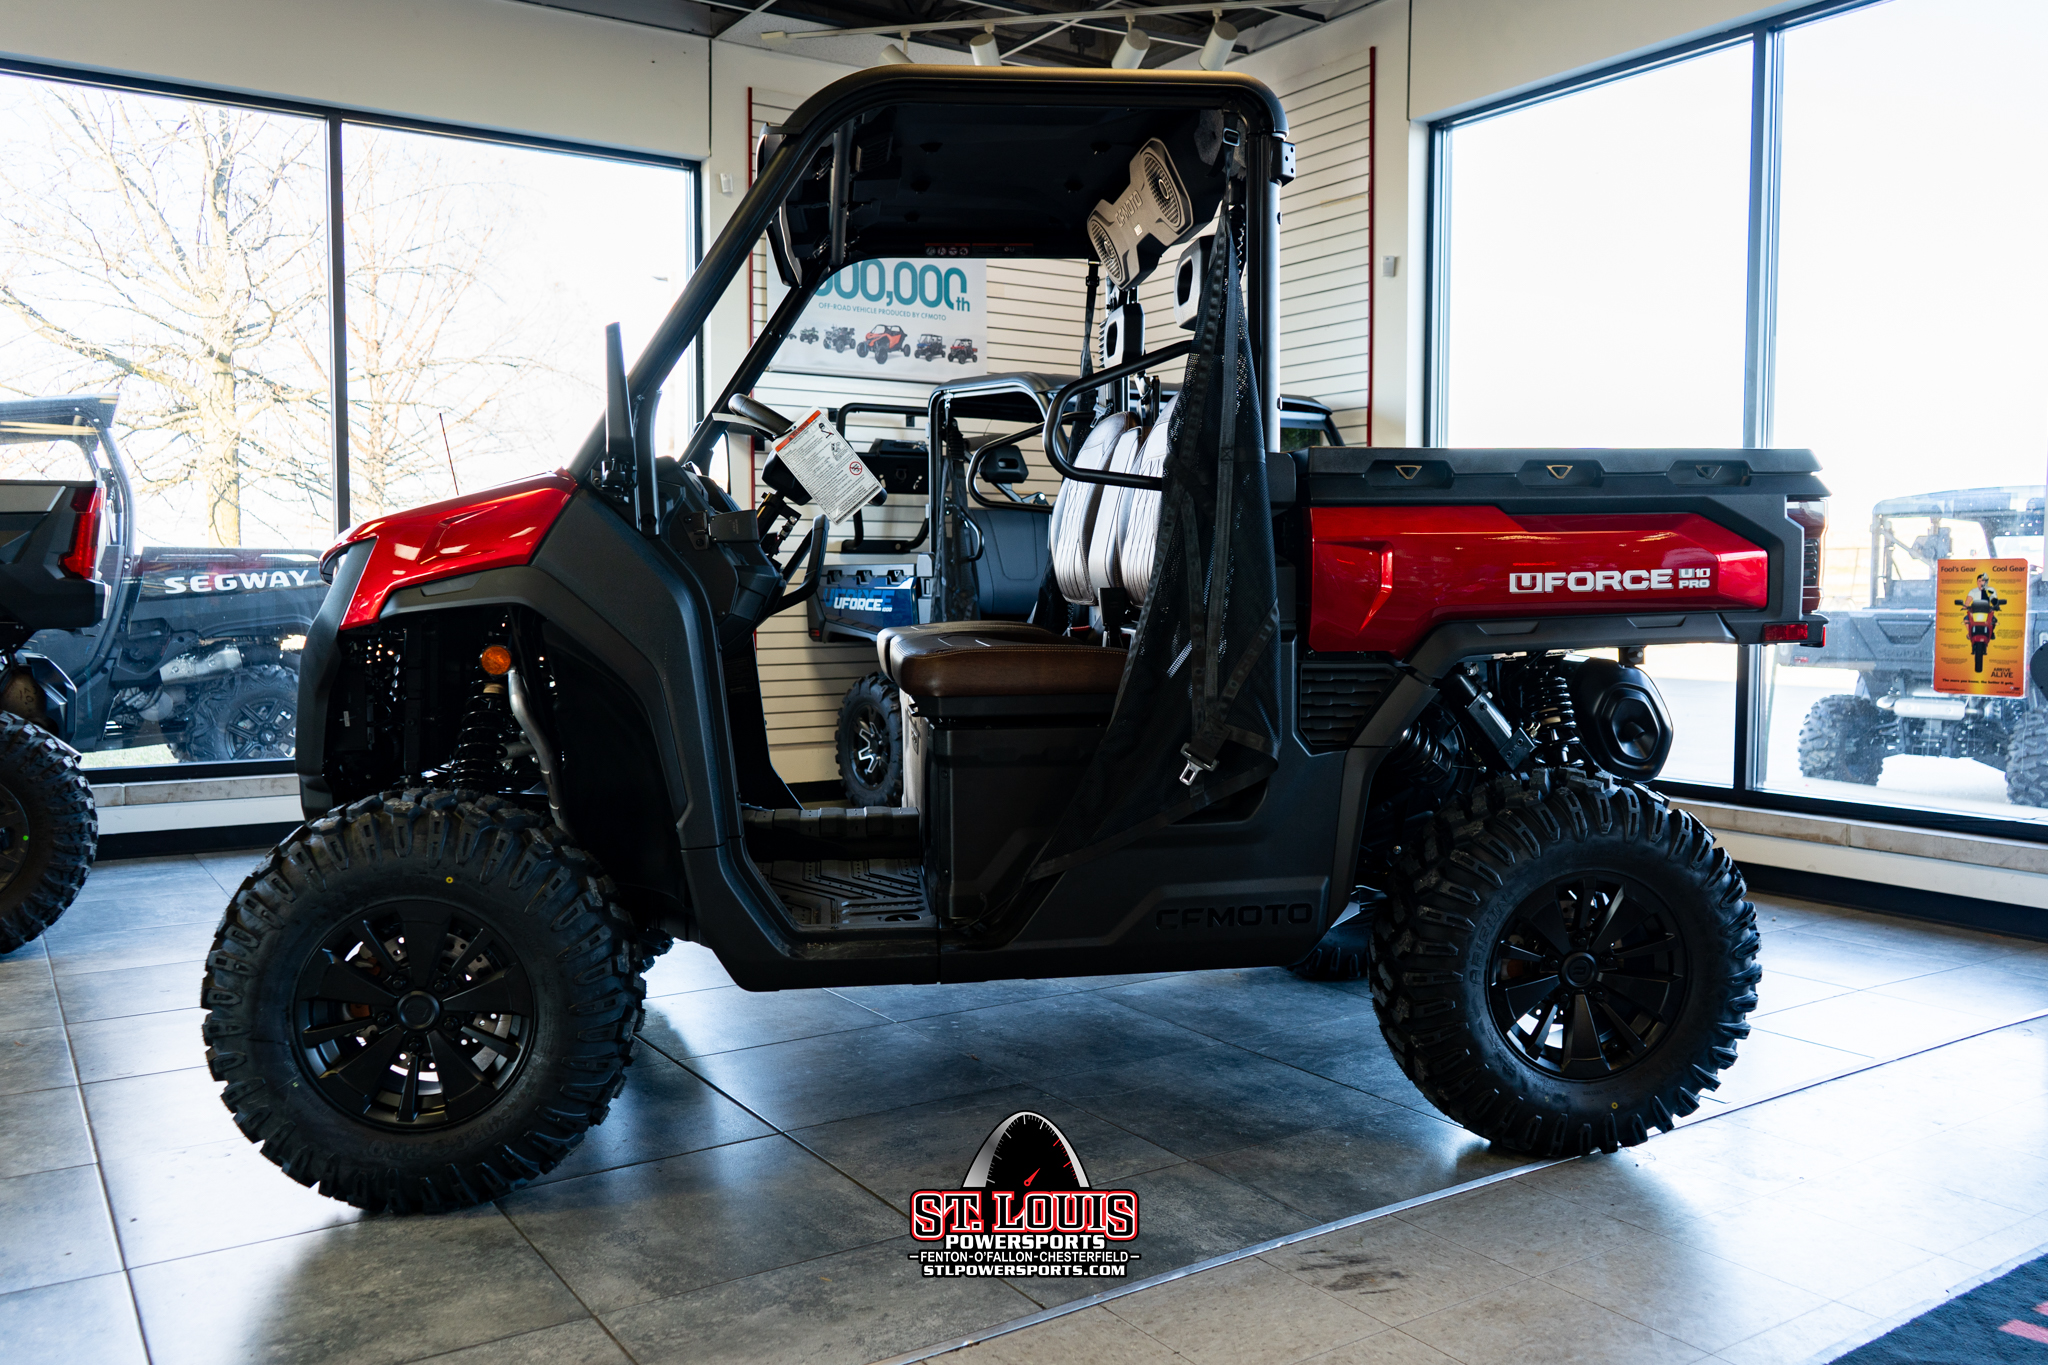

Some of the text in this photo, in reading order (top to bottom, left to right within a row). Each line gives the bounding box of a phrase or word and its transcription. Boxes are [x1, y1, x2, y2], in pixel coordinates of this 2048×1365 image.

[1115, 189, 1143, 227] CFMOTO
[818, 302, 852, 312] OFF-ROAD
[852, 305, 877, 315] VEHICLE
[878, 308, 911, 318] PRODUCED
[920, 312, 947, 321] CFMOTO
[163, 569, 309, 594] SEGWAY
[1509, 568, 1674, 594] UFORCE
[1678, 567, 1711, 579] U10
[1678, 579, 1711, 589] PRO
[833, 597, 883, 612] UFORCE
[1155, 903, 1313, 930] CFMOTO
